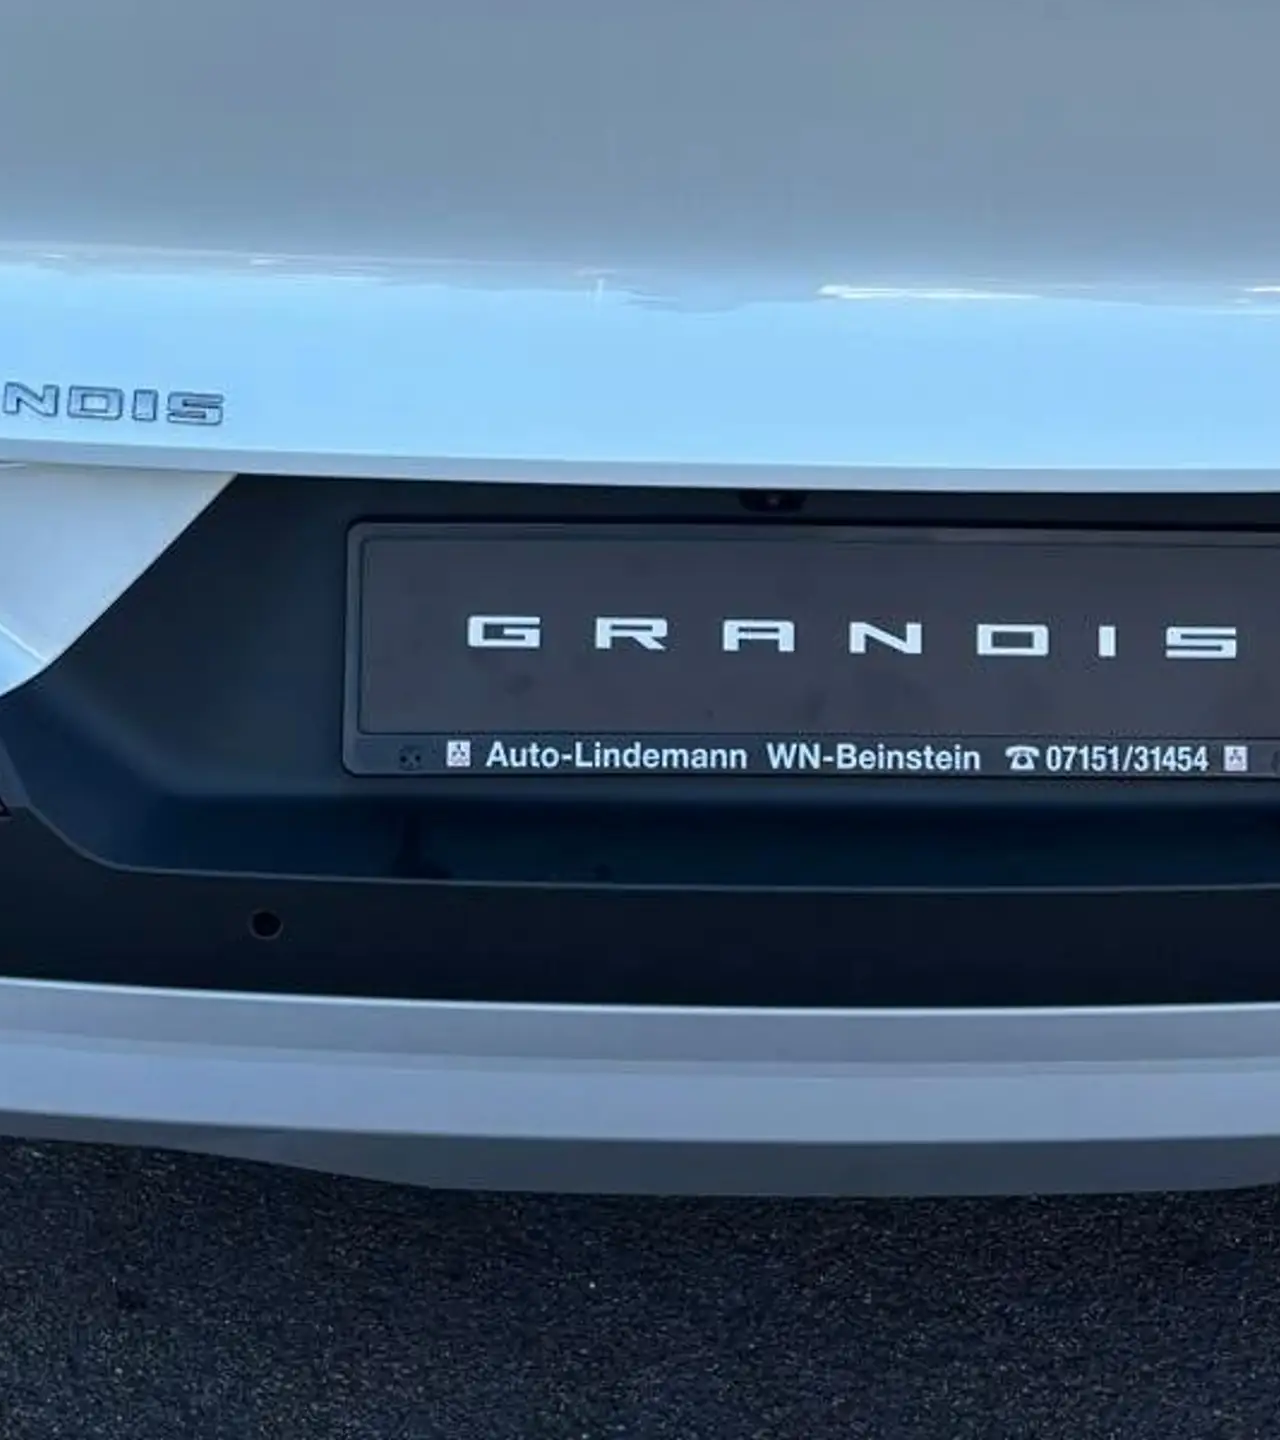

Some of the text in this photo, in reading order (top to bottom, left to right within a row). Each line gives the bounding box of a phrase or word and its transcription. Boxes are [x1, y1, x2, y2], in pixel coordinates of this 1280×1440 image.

[467, 615, 1238, 659] GRANDIS
[485, 740, 1209, 773] Auto-Lindemann WN-Beinstein 07151/31454
